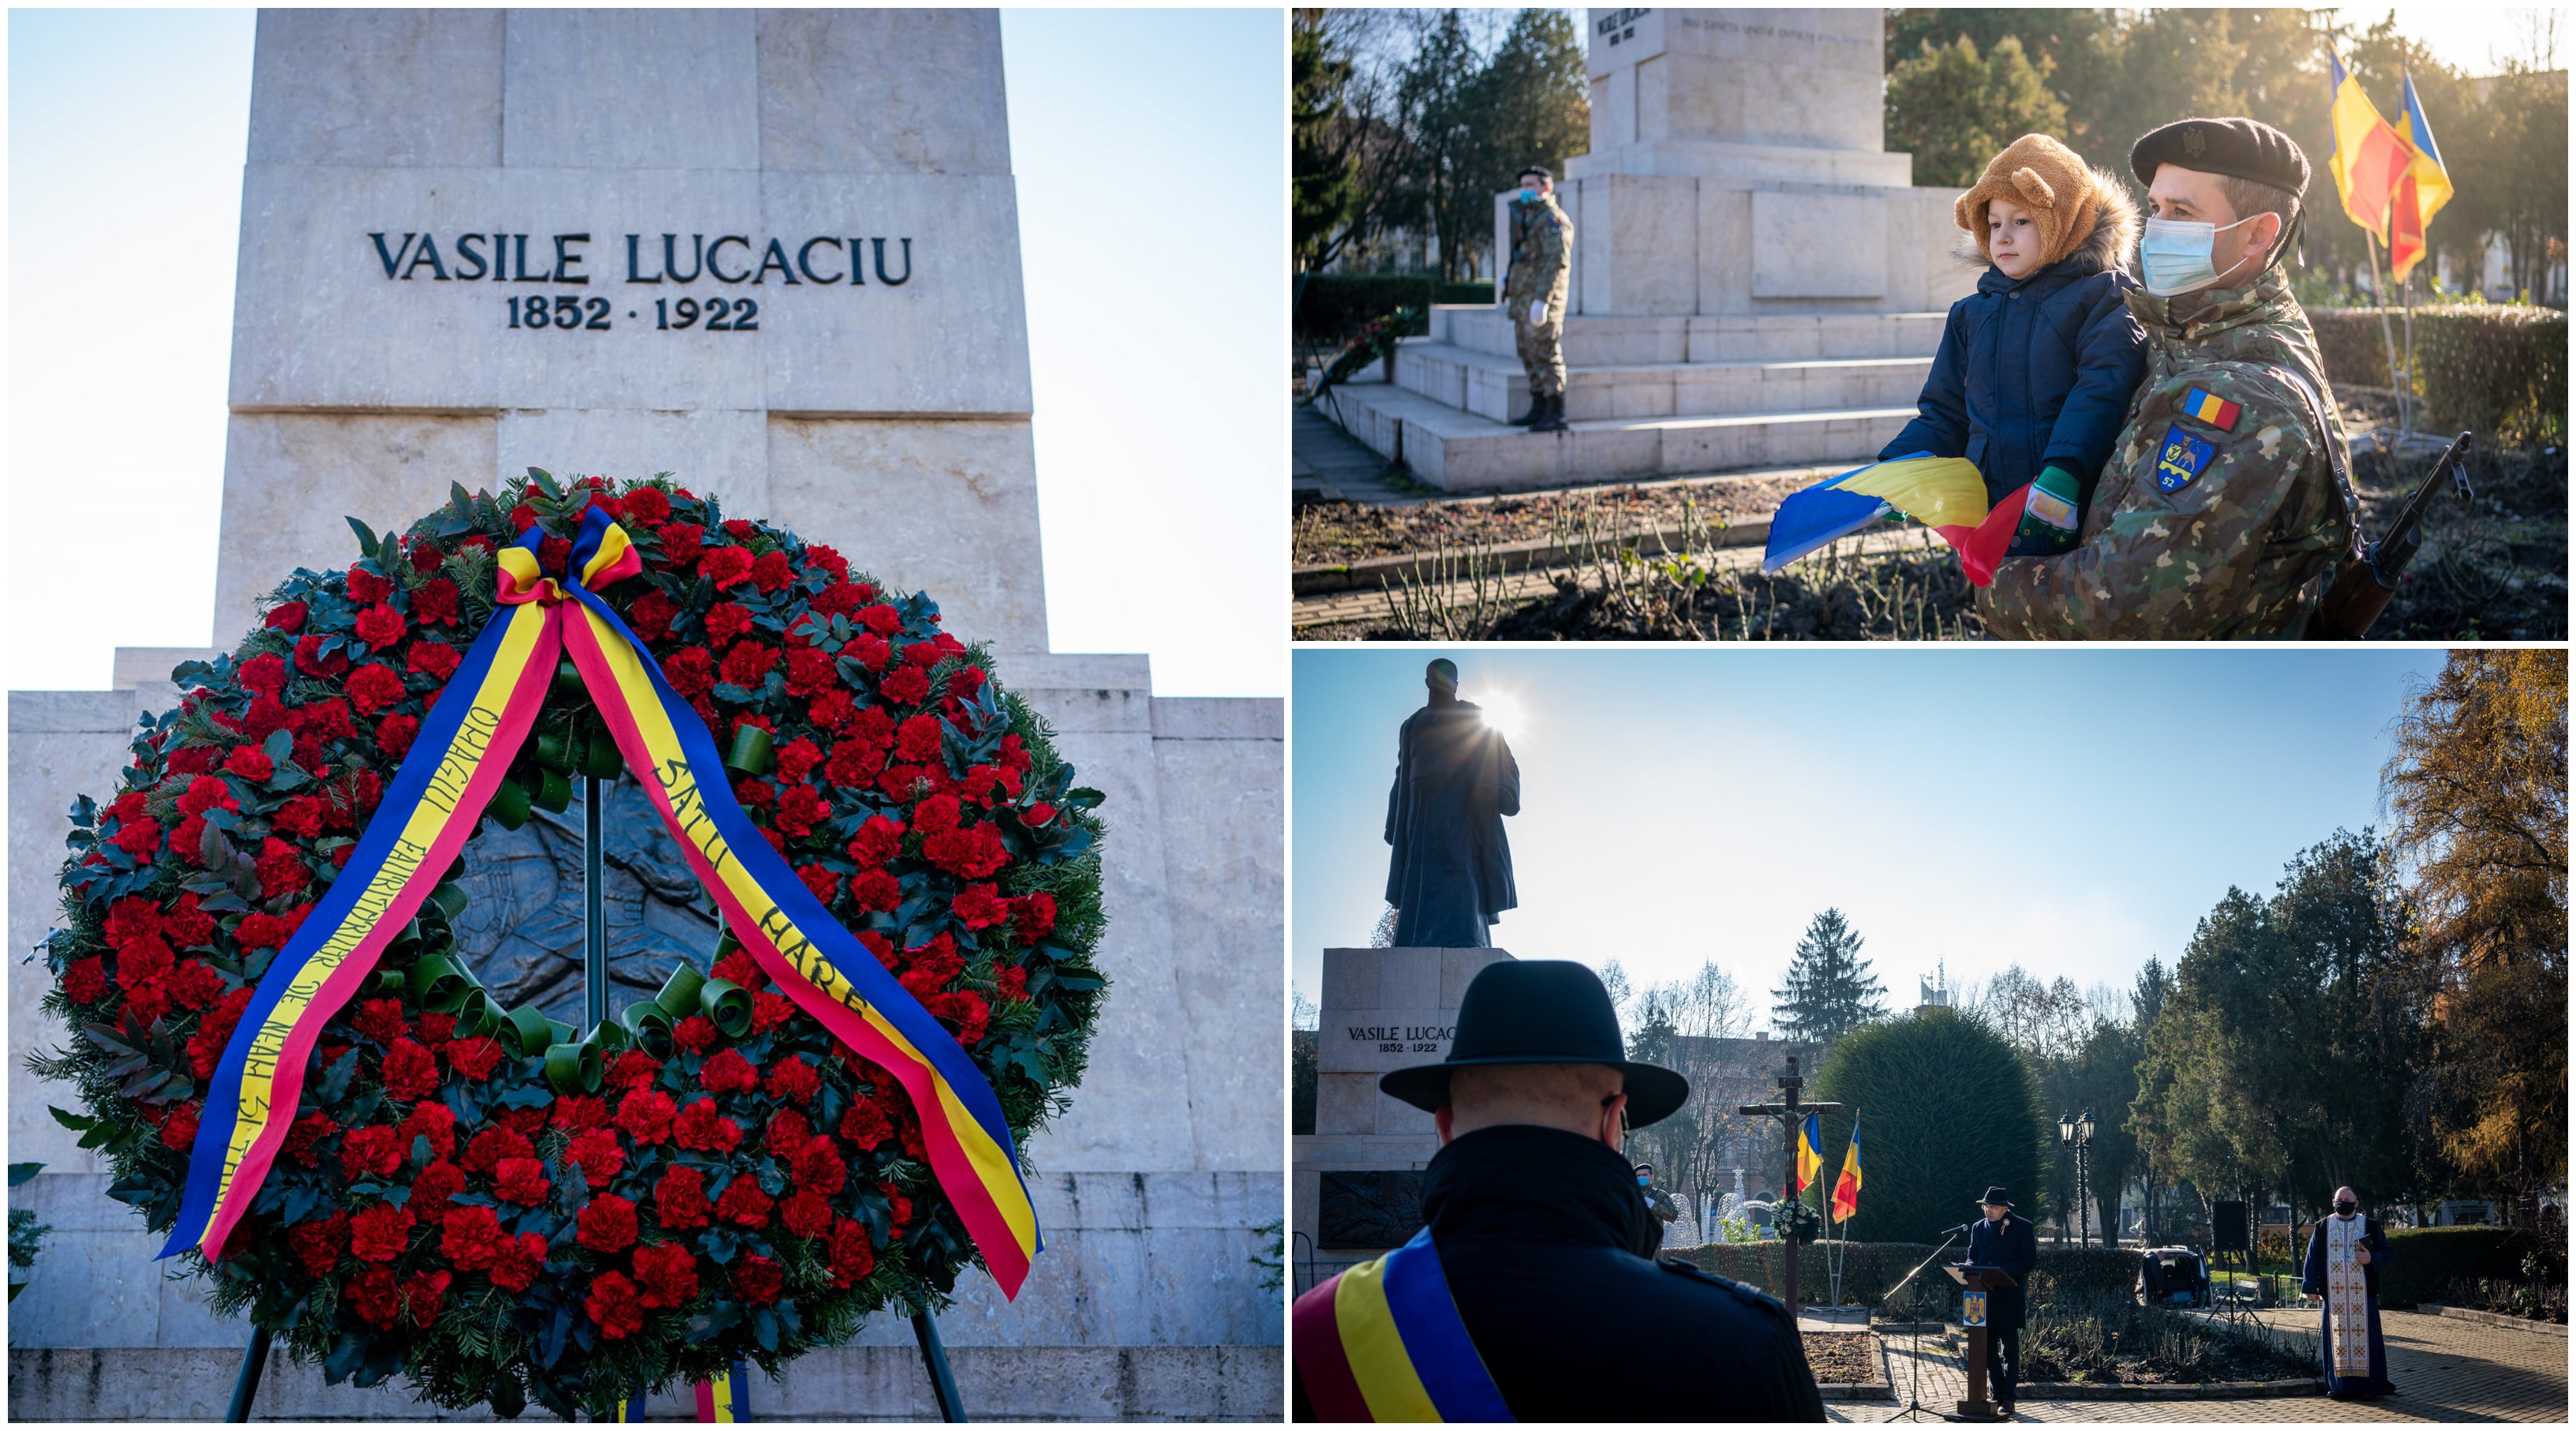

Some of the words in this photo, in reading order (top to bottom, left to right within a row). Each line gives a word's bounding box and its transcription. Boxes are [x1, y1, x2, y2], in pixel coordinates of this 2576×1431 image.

[367, 233, 590, 285] VASILE
[625, 234, 912, 287] LUCACIU
[507, 295, 612, 330] 1852
[656, 297, 759, 332] 1922
[2162, 477, 2174, 487] 52
[421, 706, 500, 814] OMAGIU
[650, 758, 728, 872] SATU
[759, 905, 867, 1018] MARE
[281, 980, 321, 1007] DE
[244, 1020, 294, 1080] NEAM
[1348, 1027, 1399, 1041] VASILE
[1406, 1026, 1457, 1040] LUCAC
[1379, 1043, 1403, 1053] 1852
[1413, 1043, 1437, 1052] 1922
